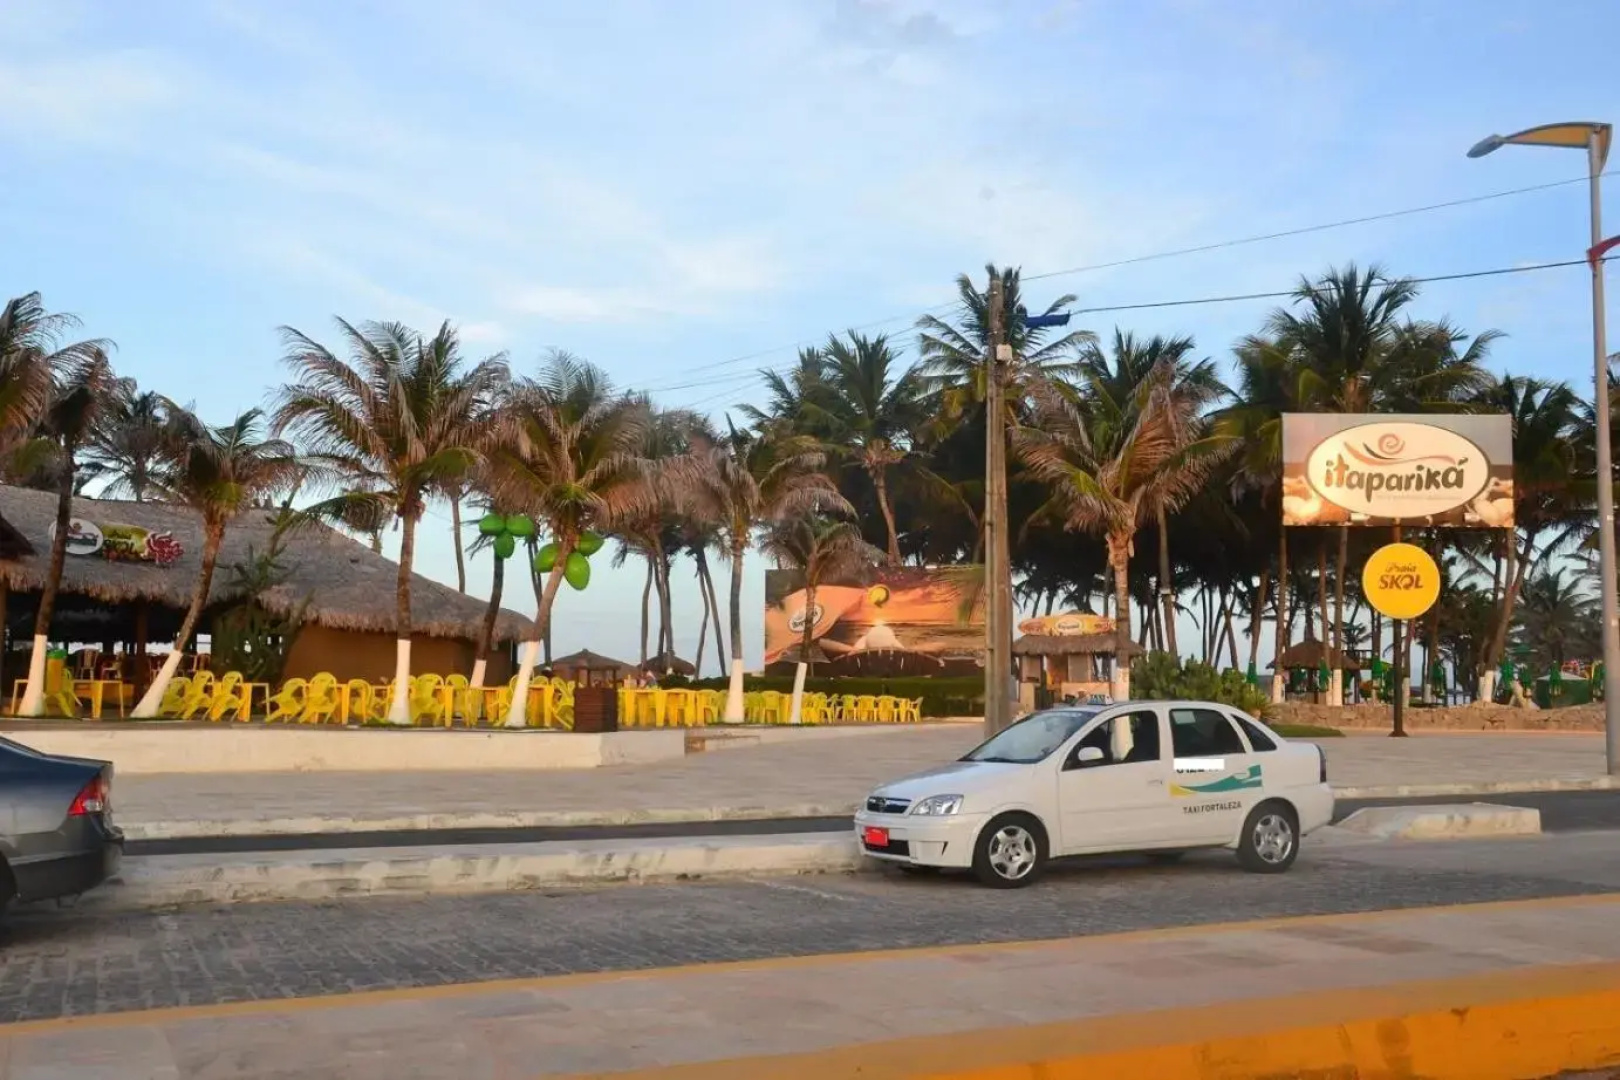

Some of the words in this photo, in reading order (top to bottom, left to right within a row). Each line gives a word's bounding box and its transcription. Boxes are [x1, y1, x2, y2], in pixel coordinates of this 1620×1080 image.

[1379, 574, 1424, 590] SKOL
[1183, 806, 1200, 815] TAXI
[1201, 801, 1242, 813] FORTALEZA
